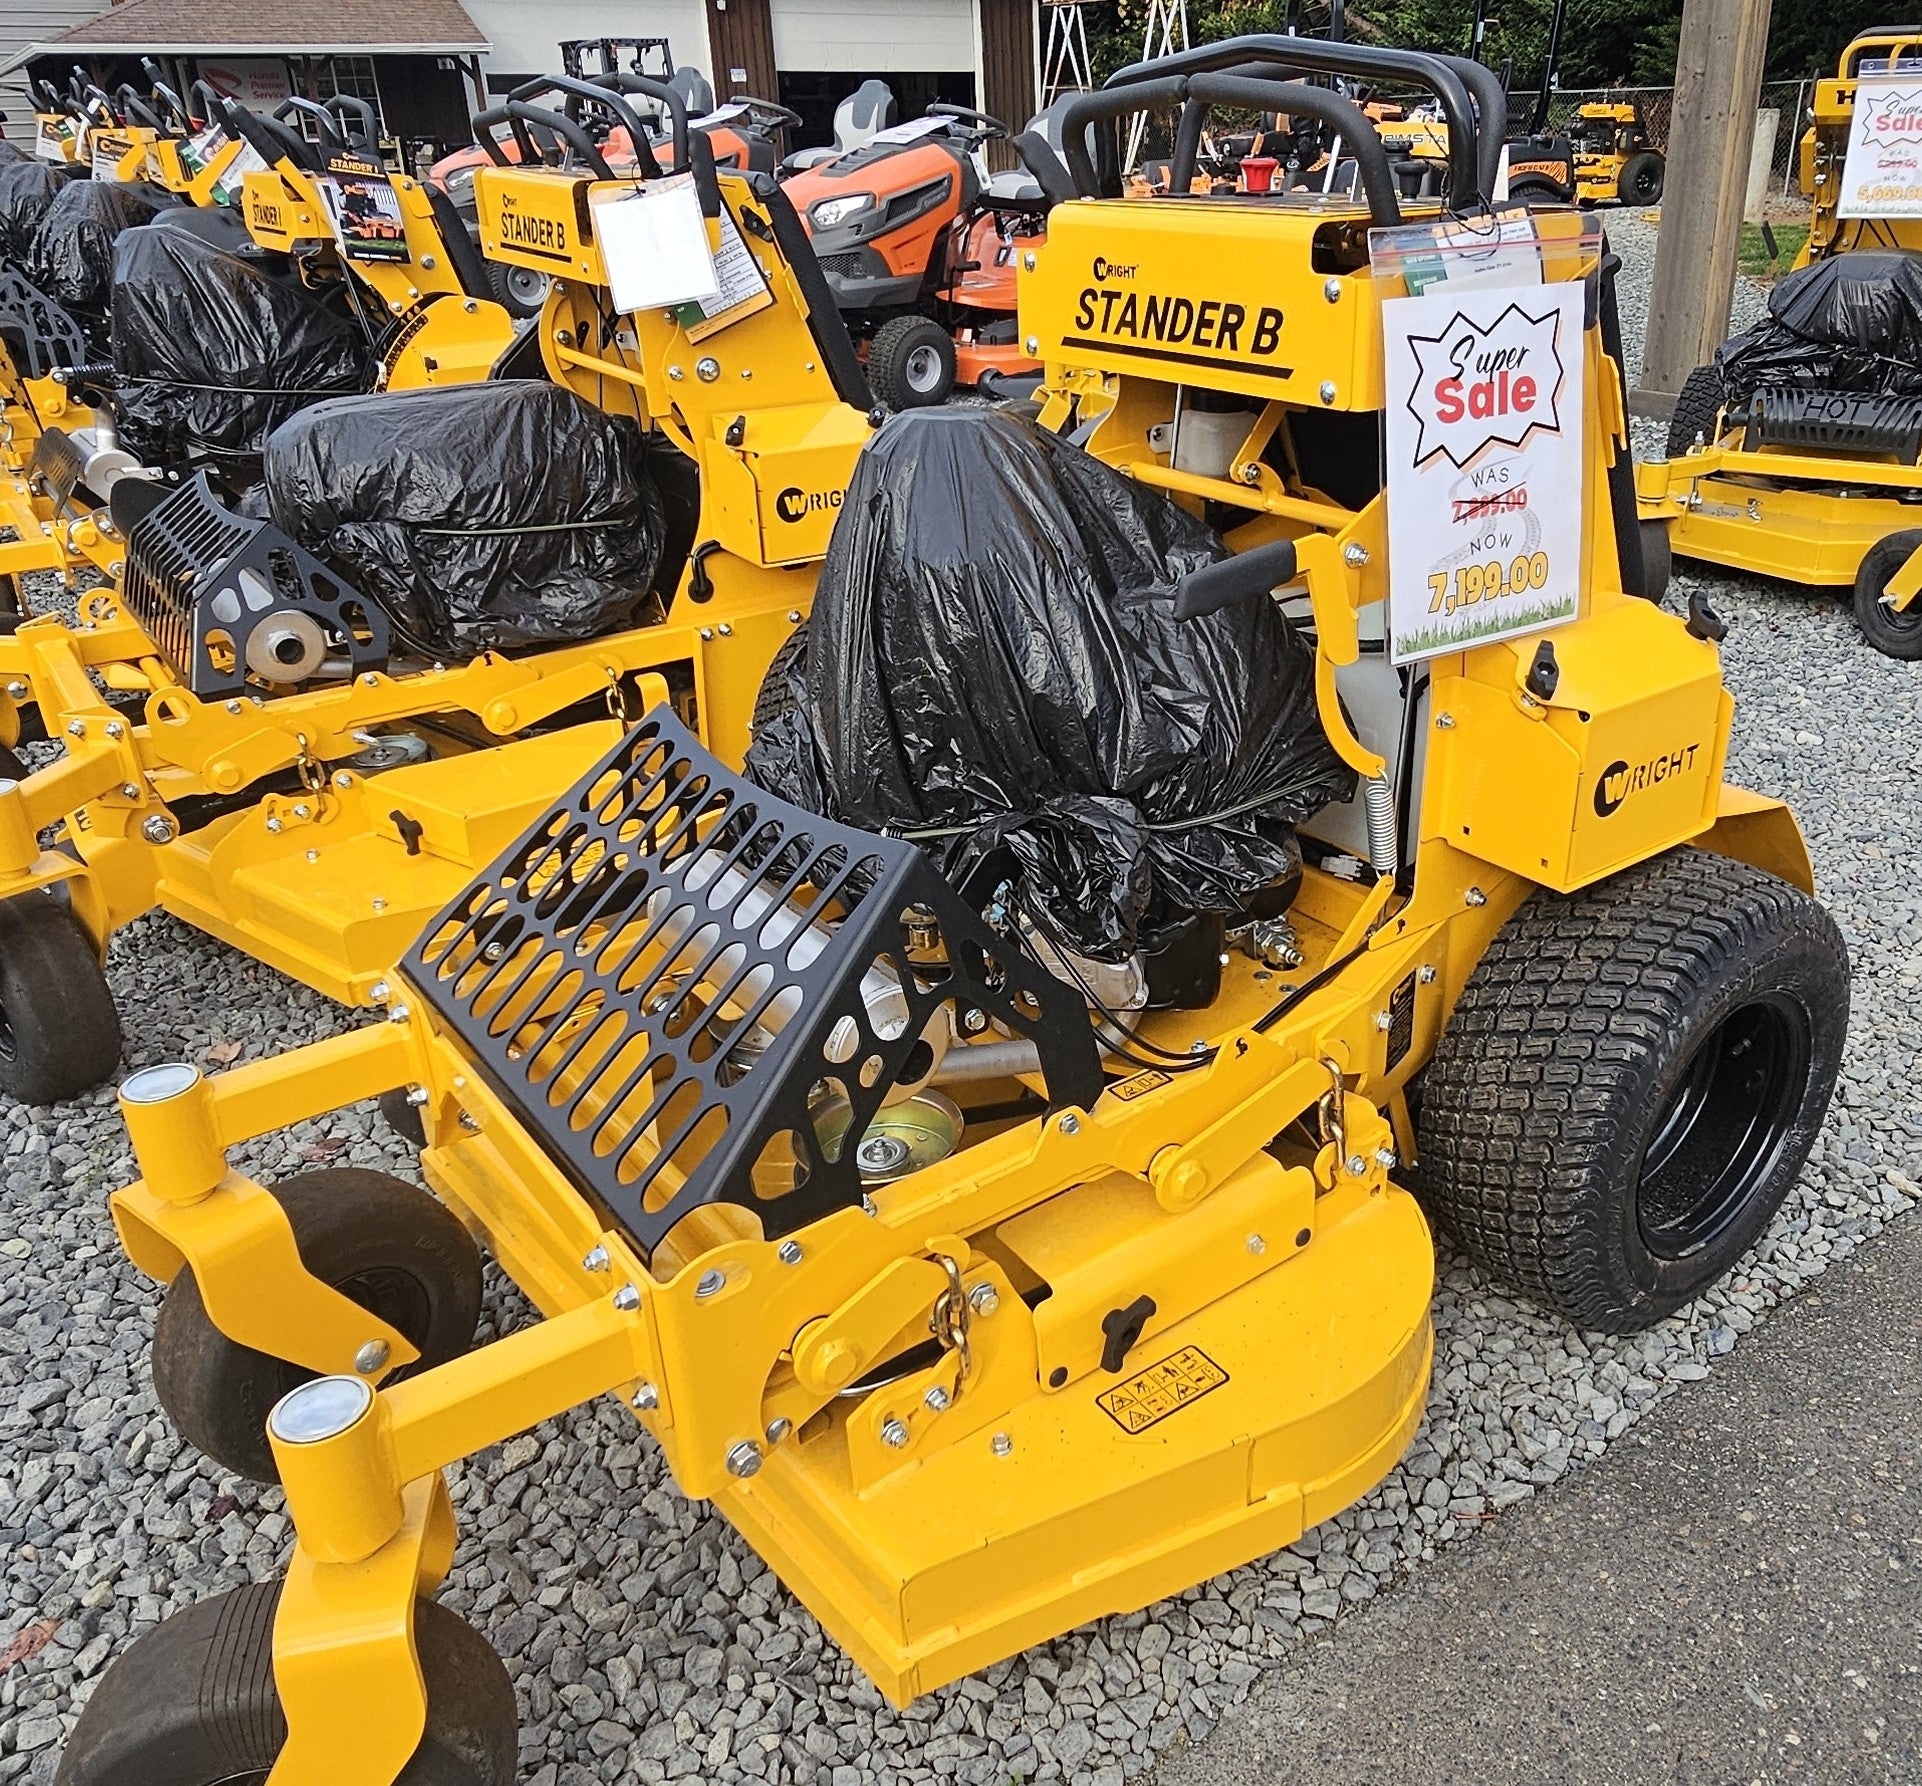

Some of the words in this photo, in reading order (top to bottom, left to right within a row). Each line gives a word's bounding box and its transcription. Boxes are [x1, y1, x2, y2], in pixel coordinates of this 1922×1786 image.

[251, 81, 286, 90] Premier
[253, 90, 286, 99] Service
[330, 158, 373, 173] STANDER
[252, 203, 278, 226] STANDER
[501, 212, 554, 248] STANDER
[557, 221, 566, 250] B
[1093, 256, 1137, 282] WRIGHT
[1075, 287, 1246, 352] STANDER
[1250, 307, 1284, 355] B
[1449, 334, 1530, 383] Super
[1434, 370, 1537, 424] Sale
[1802, 396, 1870, 421] HOT
[1470, 467, 1510, 488] WAS
[776, 487, 847, 523] WRIG
[1469, 532, 1514, 555] NOW
[1427, 551, 1549, 617] 7,199.00
[1593, 742, 1700, 818] WRIGHT
